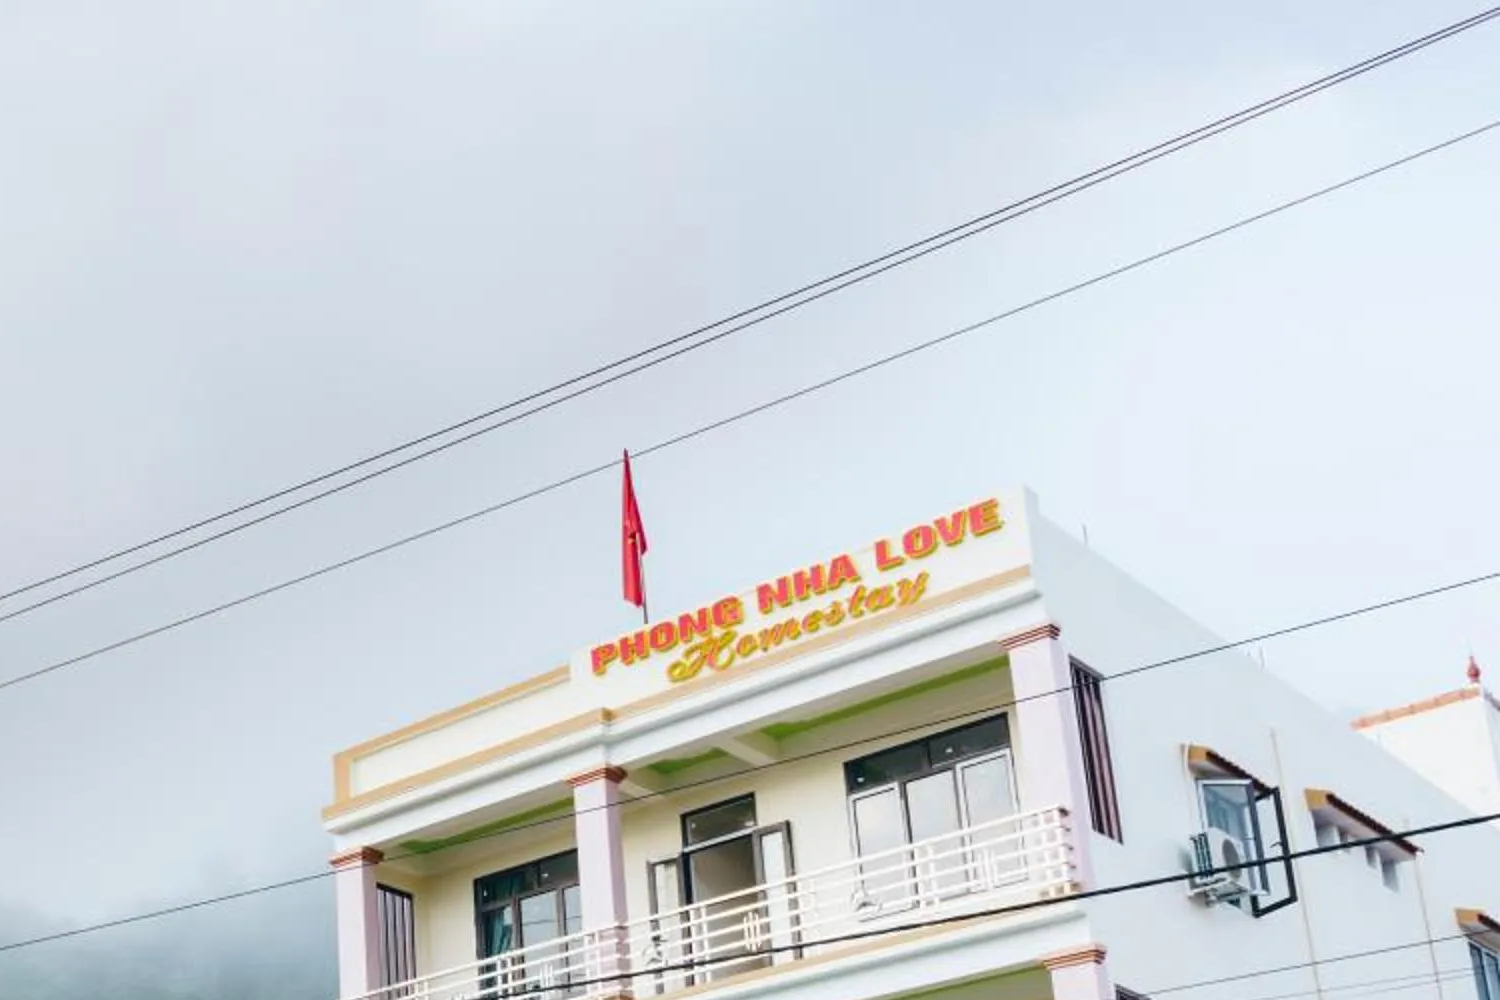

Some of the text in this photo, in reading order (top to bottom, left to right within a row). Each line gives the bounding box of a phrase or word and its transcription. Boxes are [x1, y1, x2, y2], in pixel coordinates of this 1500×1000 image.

[591, 498, 1005, 680] PHONG NHA LOVE
[666, 571, 929, 682] Homestay
